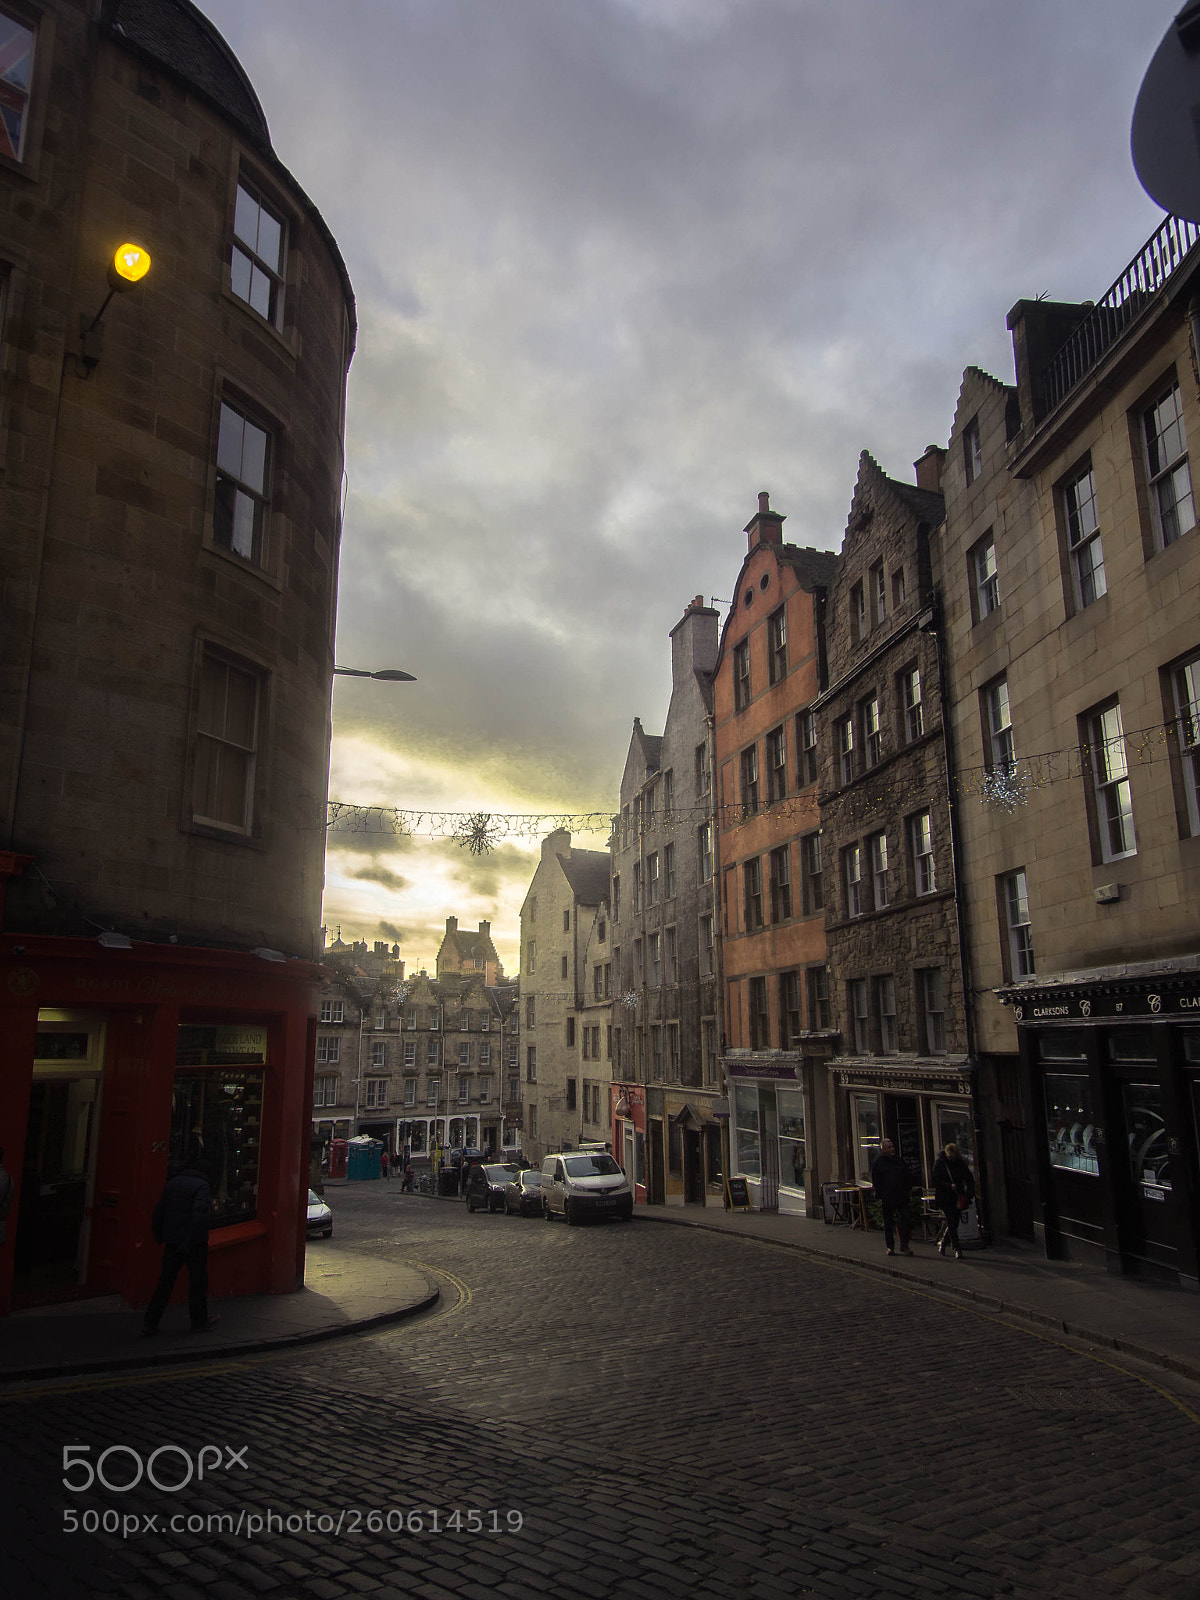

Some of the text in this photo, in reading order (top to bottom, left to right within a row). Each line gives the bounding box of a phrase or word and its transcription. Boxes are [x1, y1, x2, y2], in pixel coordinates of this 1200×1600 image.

[1033, 1006, 1069, 1017] CLARKSONS
[840, 1073, 849, 1084] 89
[958, 1081, 971, 1094] 89
[151, 1141, 167, 1153] 90
